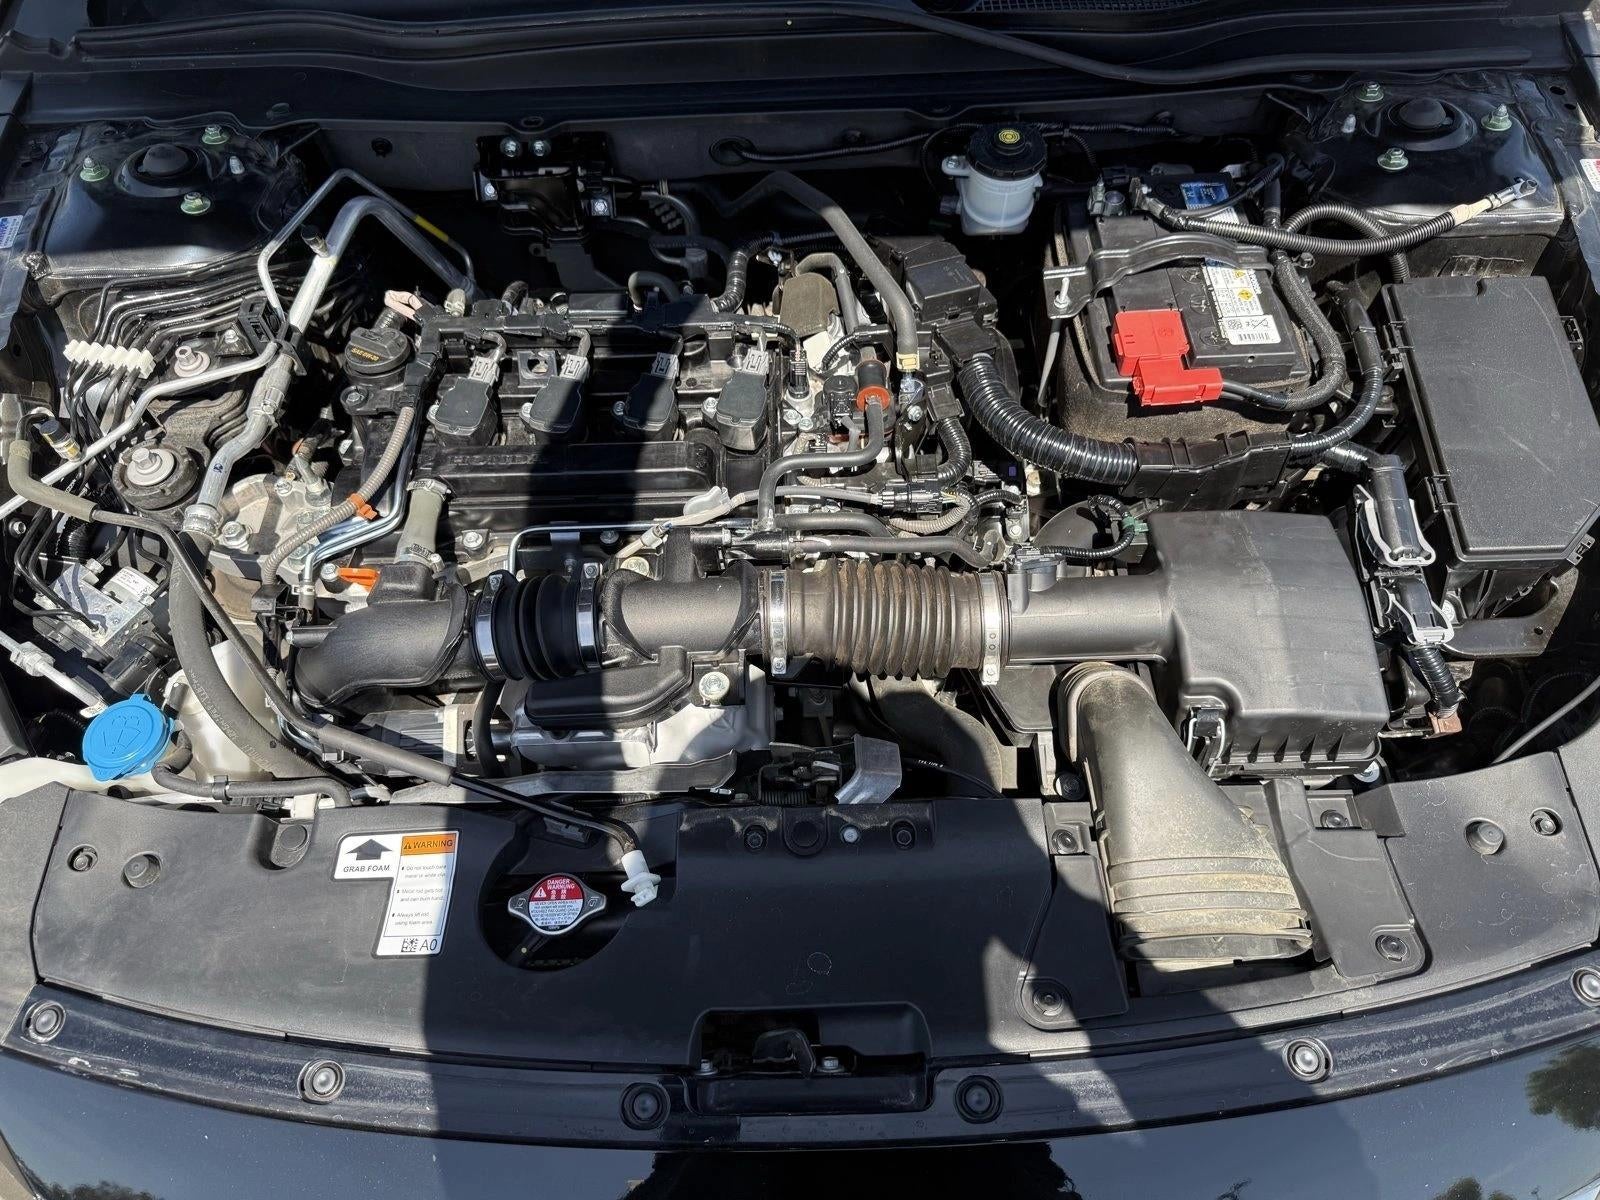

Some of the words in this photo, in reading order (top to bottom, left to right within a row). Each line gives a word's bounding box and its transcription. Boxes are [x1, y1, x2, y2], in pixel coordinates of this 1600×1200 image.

[351, 347, 364, 356] SAE
[413, 839, 452, 848] WARNING
[367, 864, 390, 872] FOAM
[419, 938, 438, 952] A0
